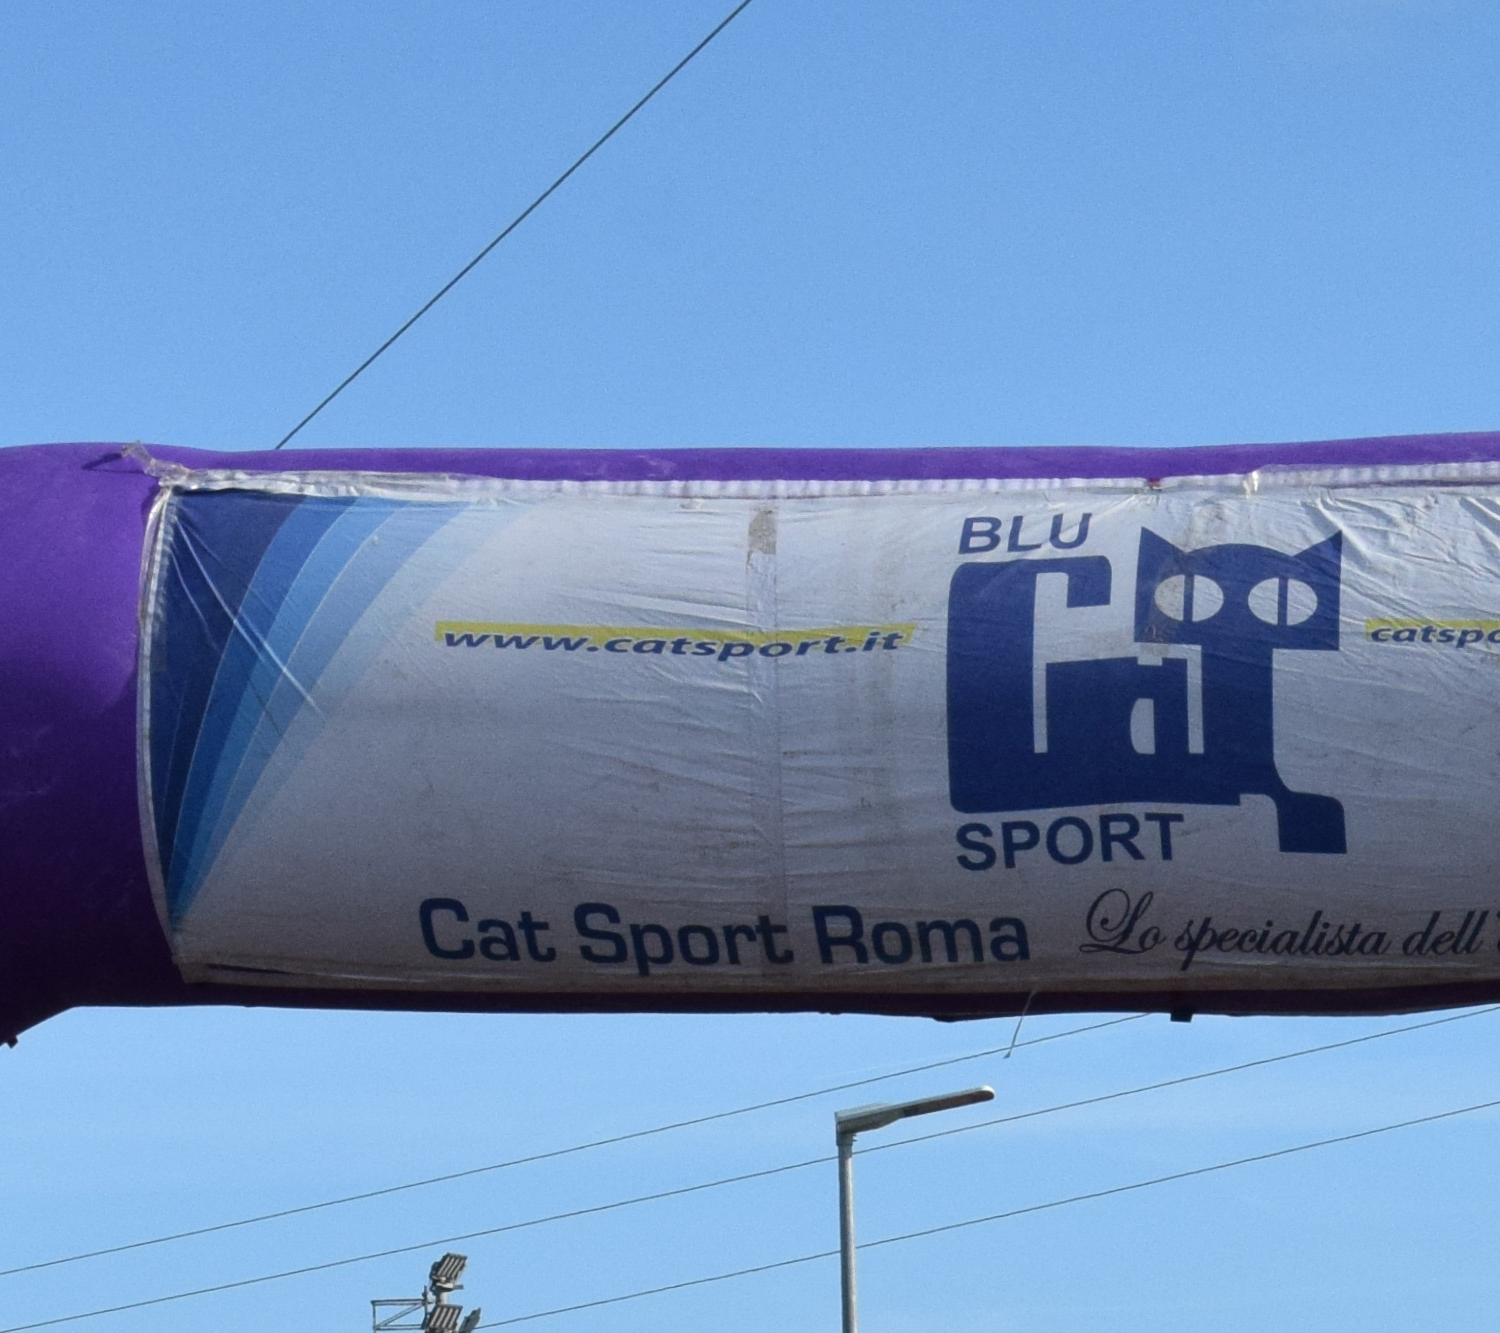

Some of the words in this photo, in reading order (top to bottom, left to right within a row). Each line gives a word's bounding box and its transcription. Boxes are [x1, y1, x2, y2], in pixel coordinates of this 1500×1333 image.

[958, 512, 1092, 555] BLU
[444, 630, 904, 662] www.catsport.it
[956, 812, 1185, 872] SPORT
[419, 897, 557, 963] Cat
[573, 902, 794, 978] Sport
[812, 904, 1031, 966] Roma
[1079, 888, 1168, 955] Lo
[1174, 910, 1392, 971] specialista
